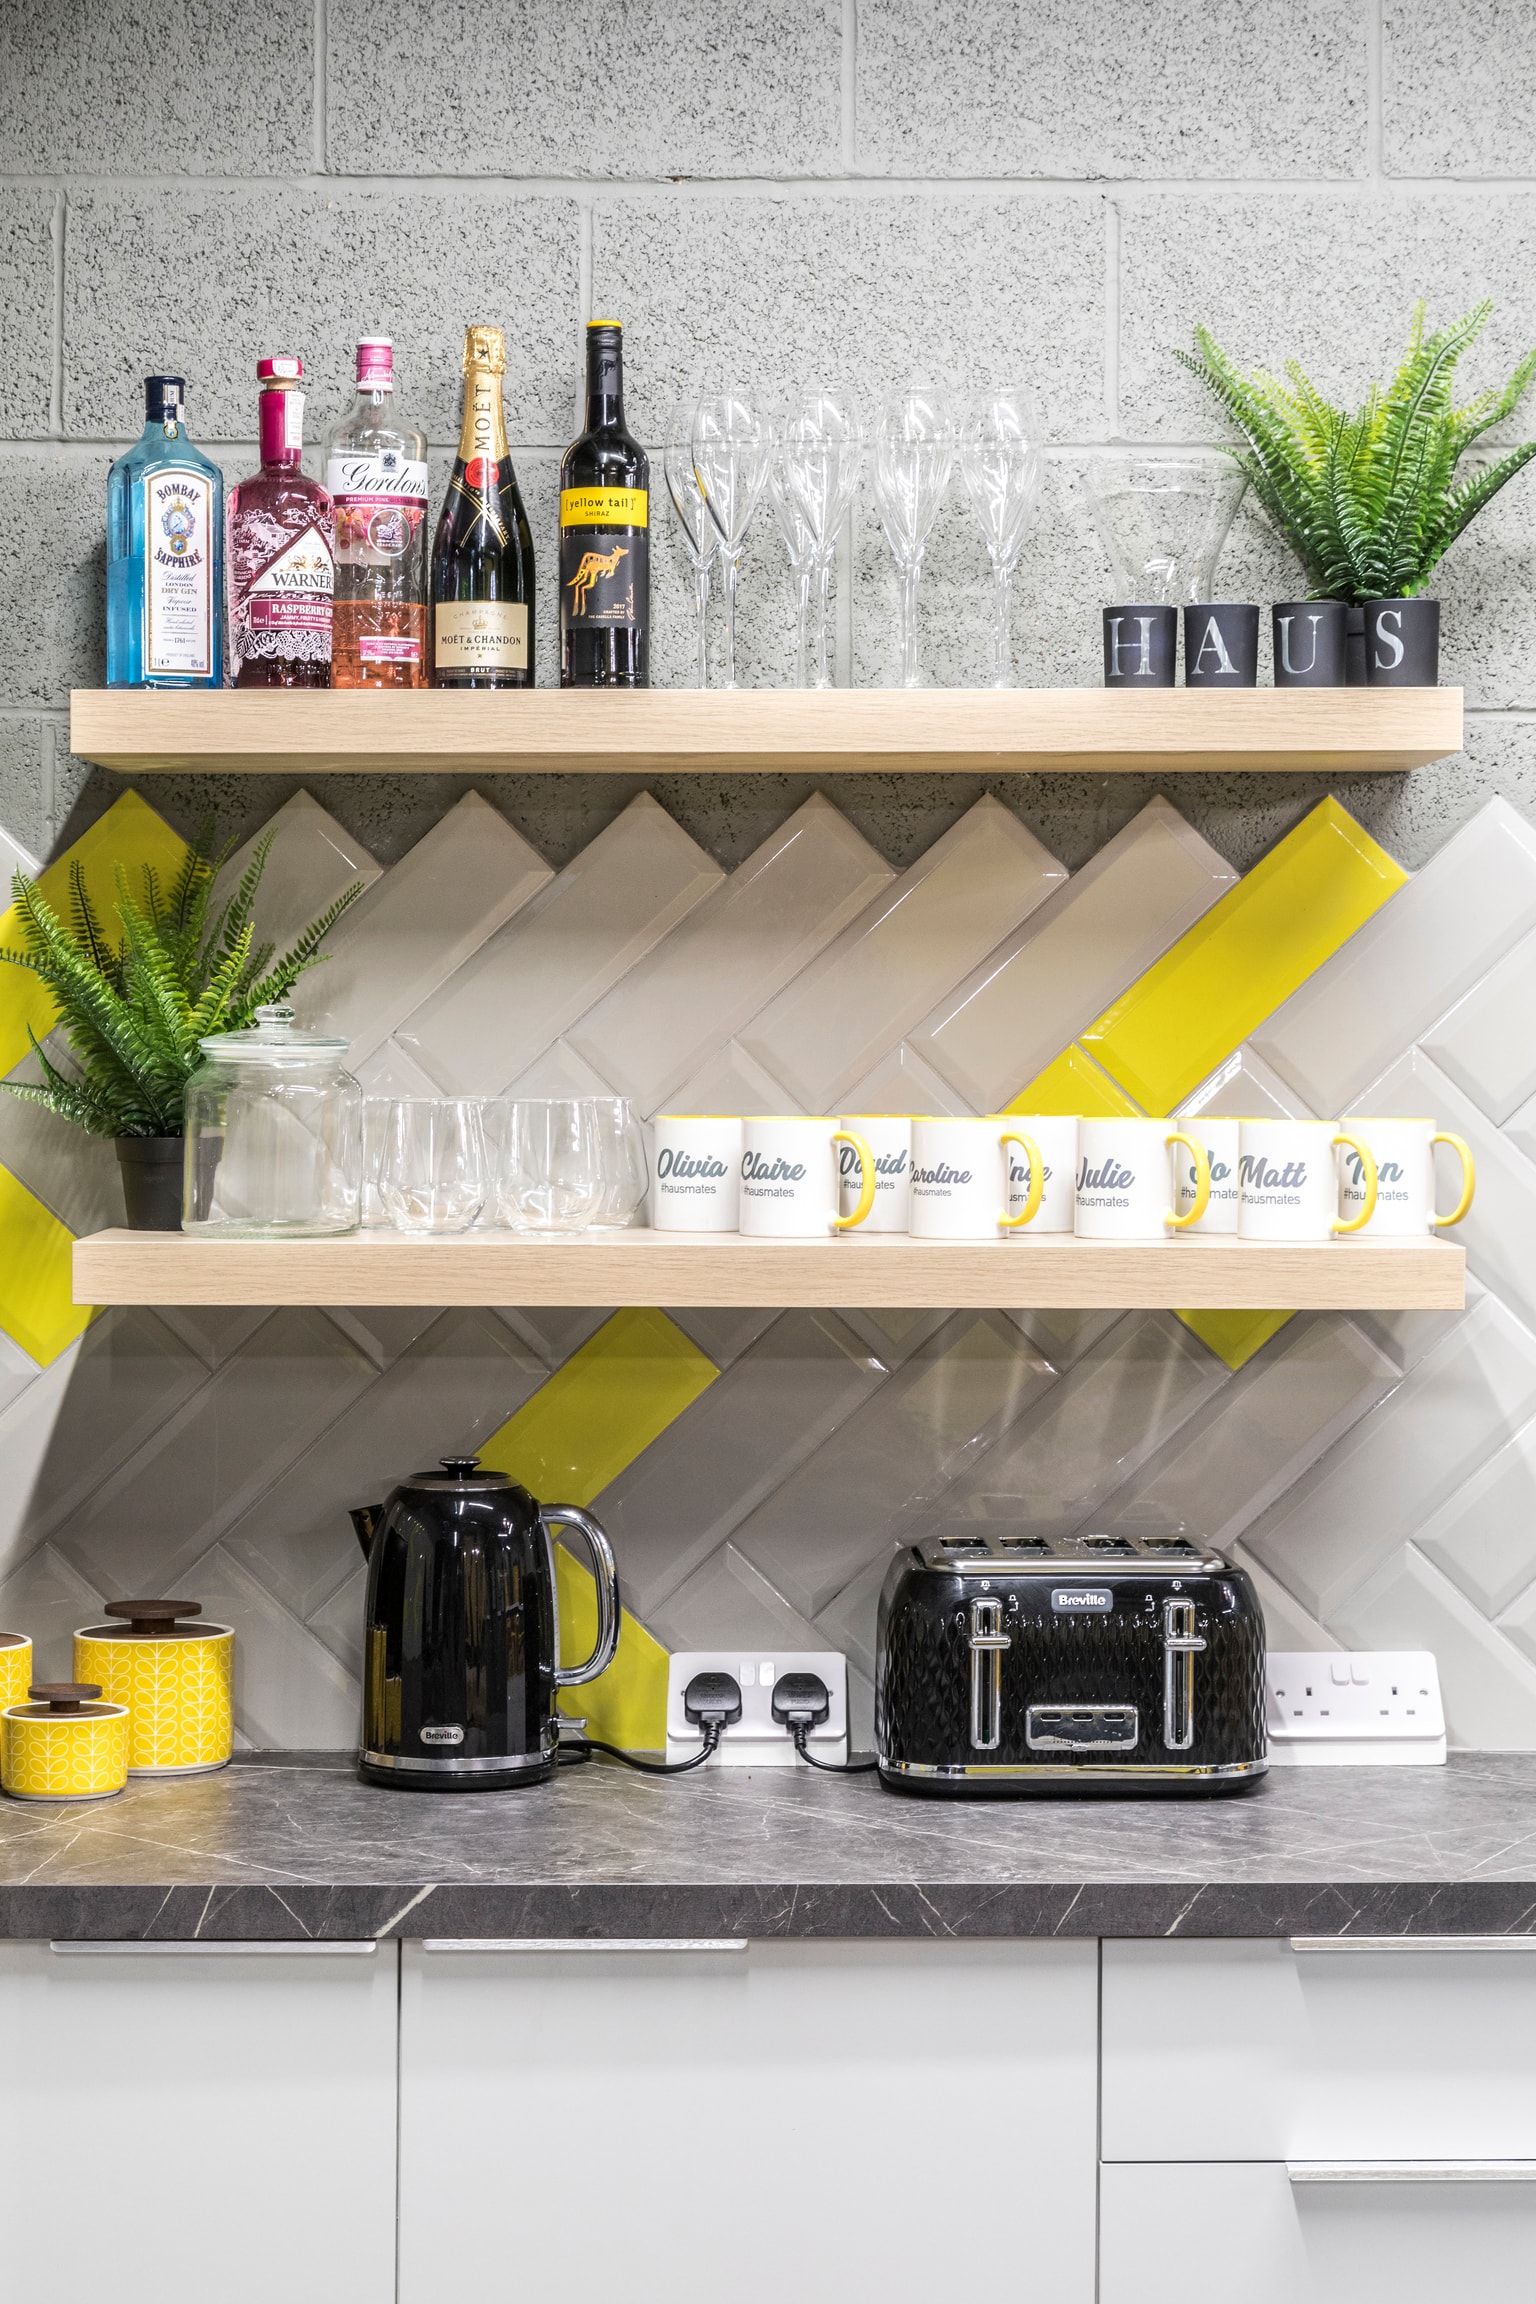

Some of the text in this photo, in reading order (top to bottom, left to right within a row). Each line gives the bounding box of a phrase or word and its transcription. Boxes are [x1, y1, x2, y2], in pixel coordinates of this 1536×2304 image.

[474, 384, 491, 451] MOËT
[341, 462, 426, 496] Gordon's
[156, 483, 201, 503] BOMBAY
[154, 547, 202, 568] SAPPHIRE
[162, 571, 196, 581] Distilled
[271, 603, 325, 616] RASPBERRY
[453, 610, 507, 620] CHAMPAGNE
[441, 634, 521, 645] MOËT & CHANDON
[657, 1148, 728, 1179] Olivia
[741, 1150, 806, 1181] Claire
[1346, 1151, 1404, 1185] Tn
[1076, 1156, 1136, 1191] Julie
[1239, 1155, 1308, 1189] Matt
[661, 1184, 717, 1194] #hausmates
[1344, 1188, 1409, 1201] #haumates
[1241, 1192, 1301, 1205] #hausmates
[1058, 1593, 1106, 1606] Breville
[425, 1730, 458, 1739] Breville
